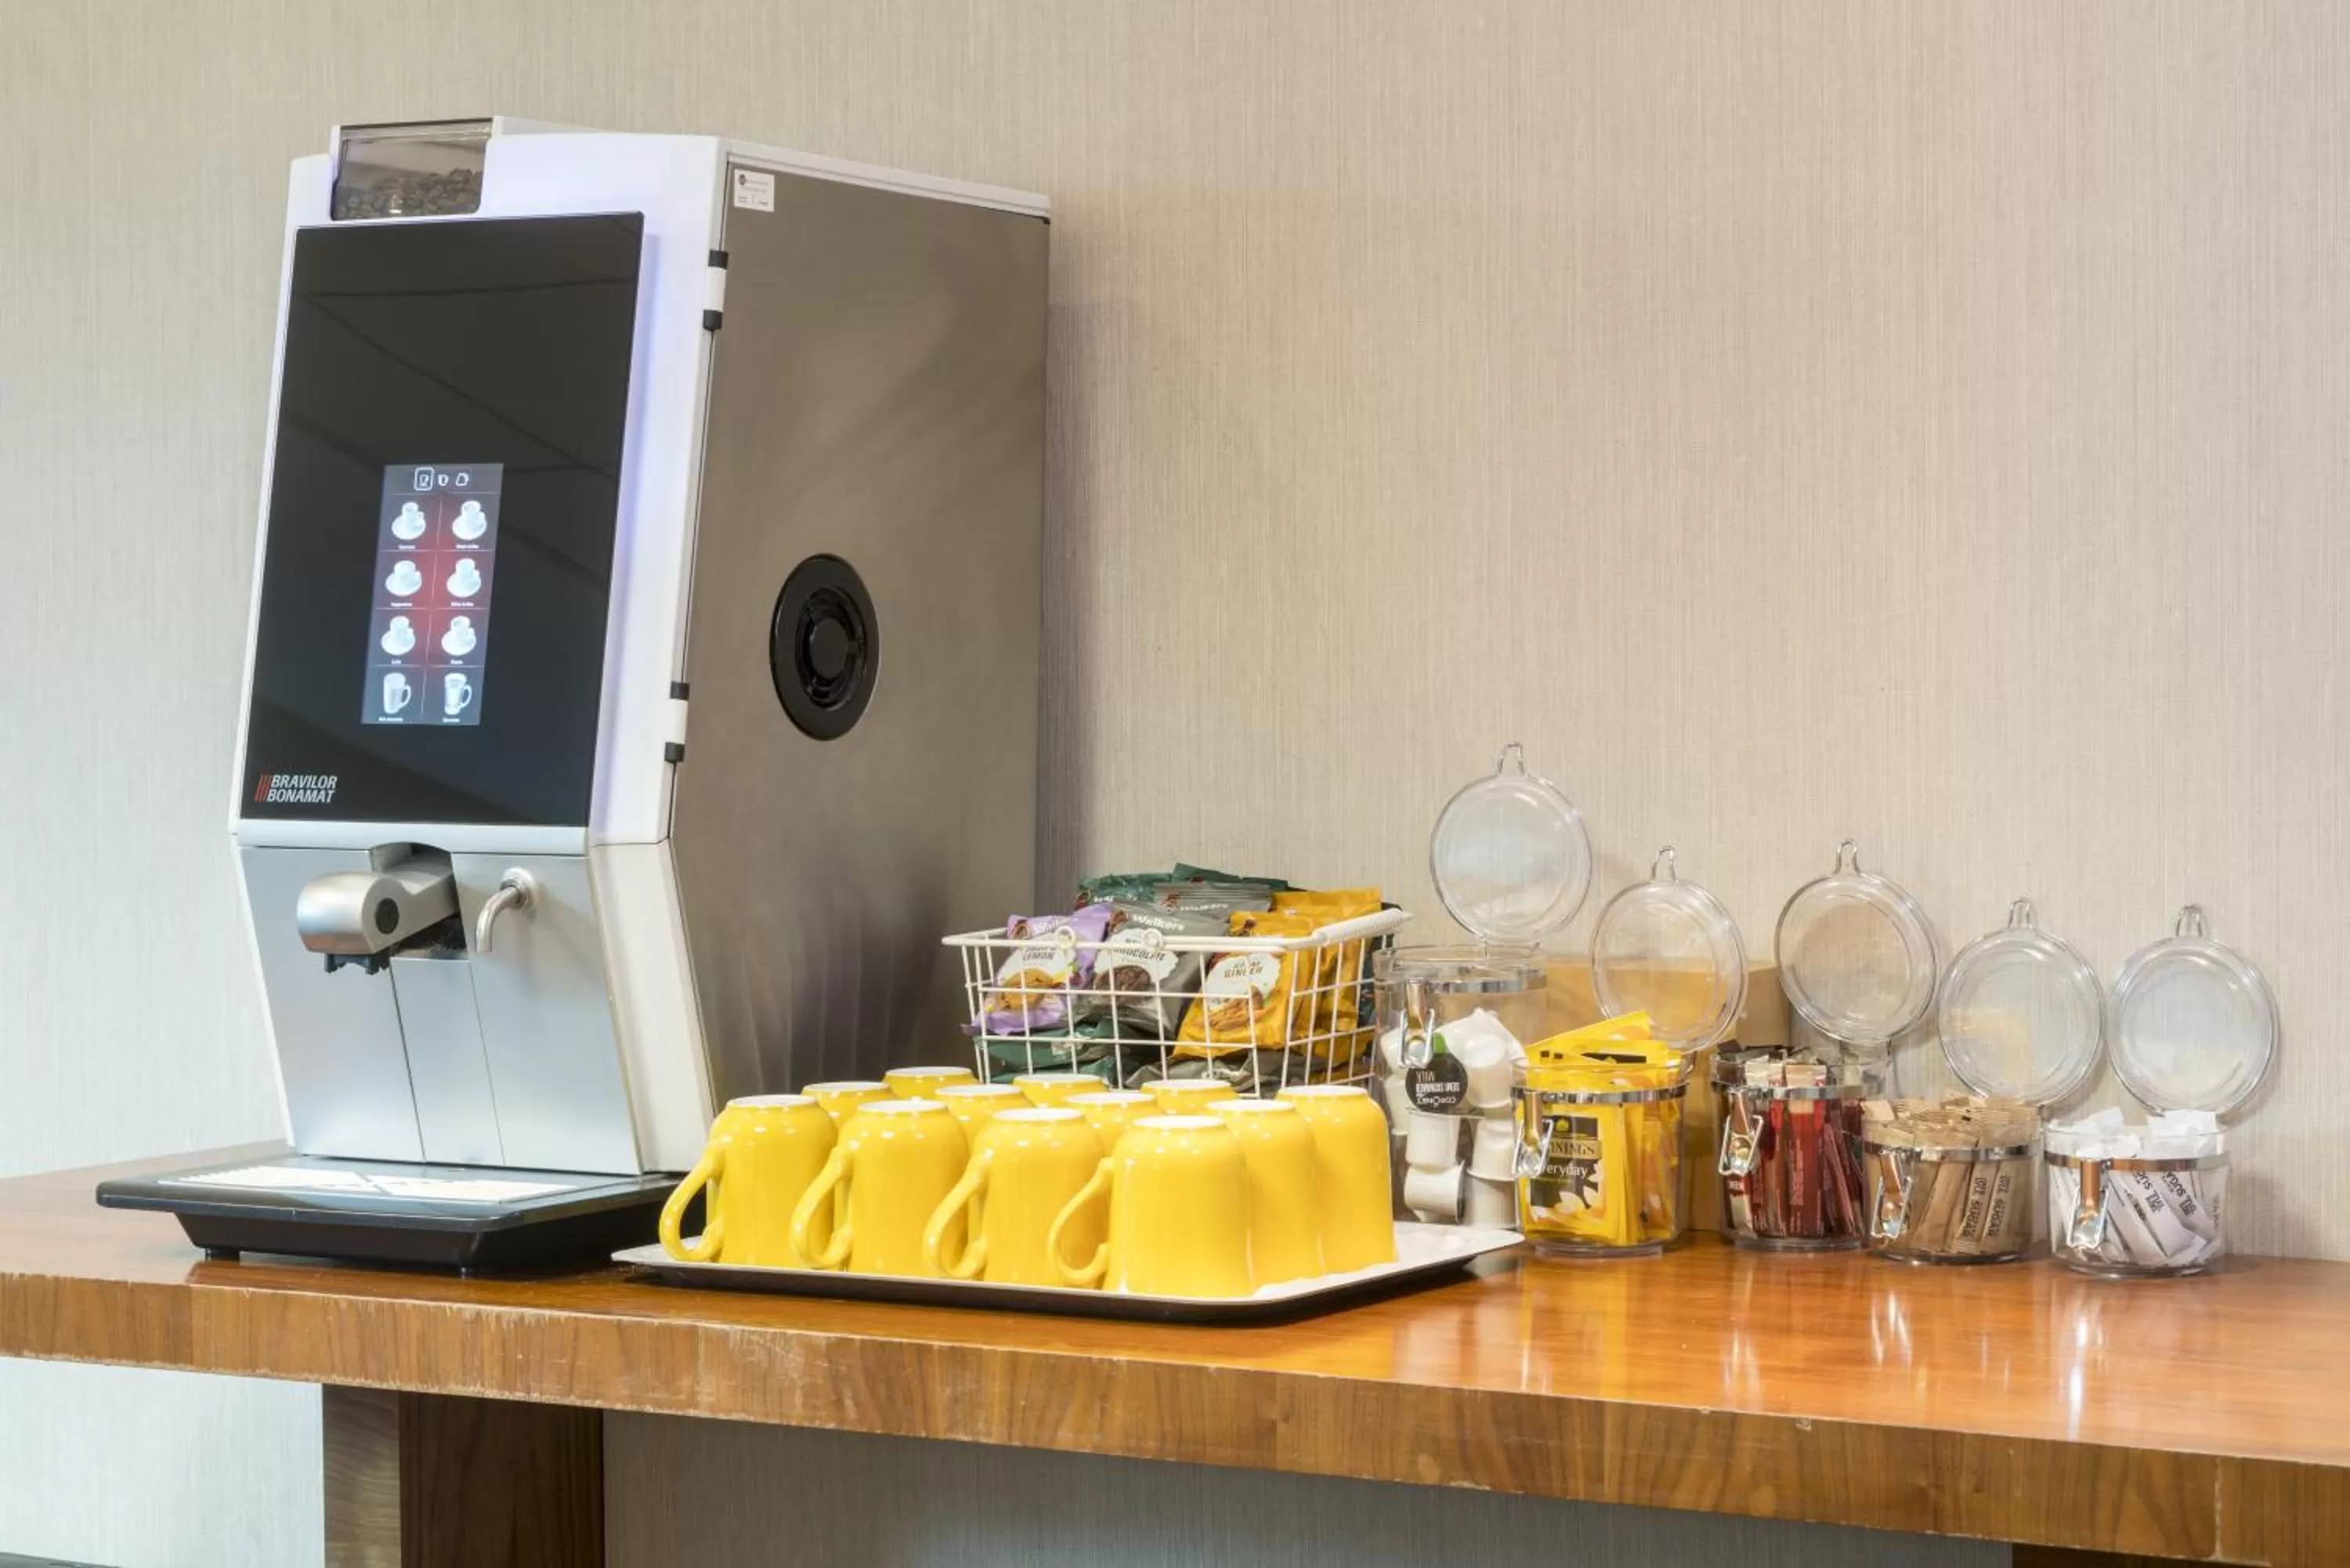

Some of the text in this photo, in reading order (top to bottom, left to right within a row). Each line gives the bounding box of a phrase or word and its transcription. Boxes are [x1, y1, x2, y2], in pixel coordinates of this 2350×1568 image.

[271, 774, 338, 788] BRAVILOR
[266, 789, 335, 803] BONAMAT
[1133, 914, 1185, 931] Walkers
[1547, 1162, 1588, 1179] eryday
[2165, 1171, 2186, 1197] SUGA
